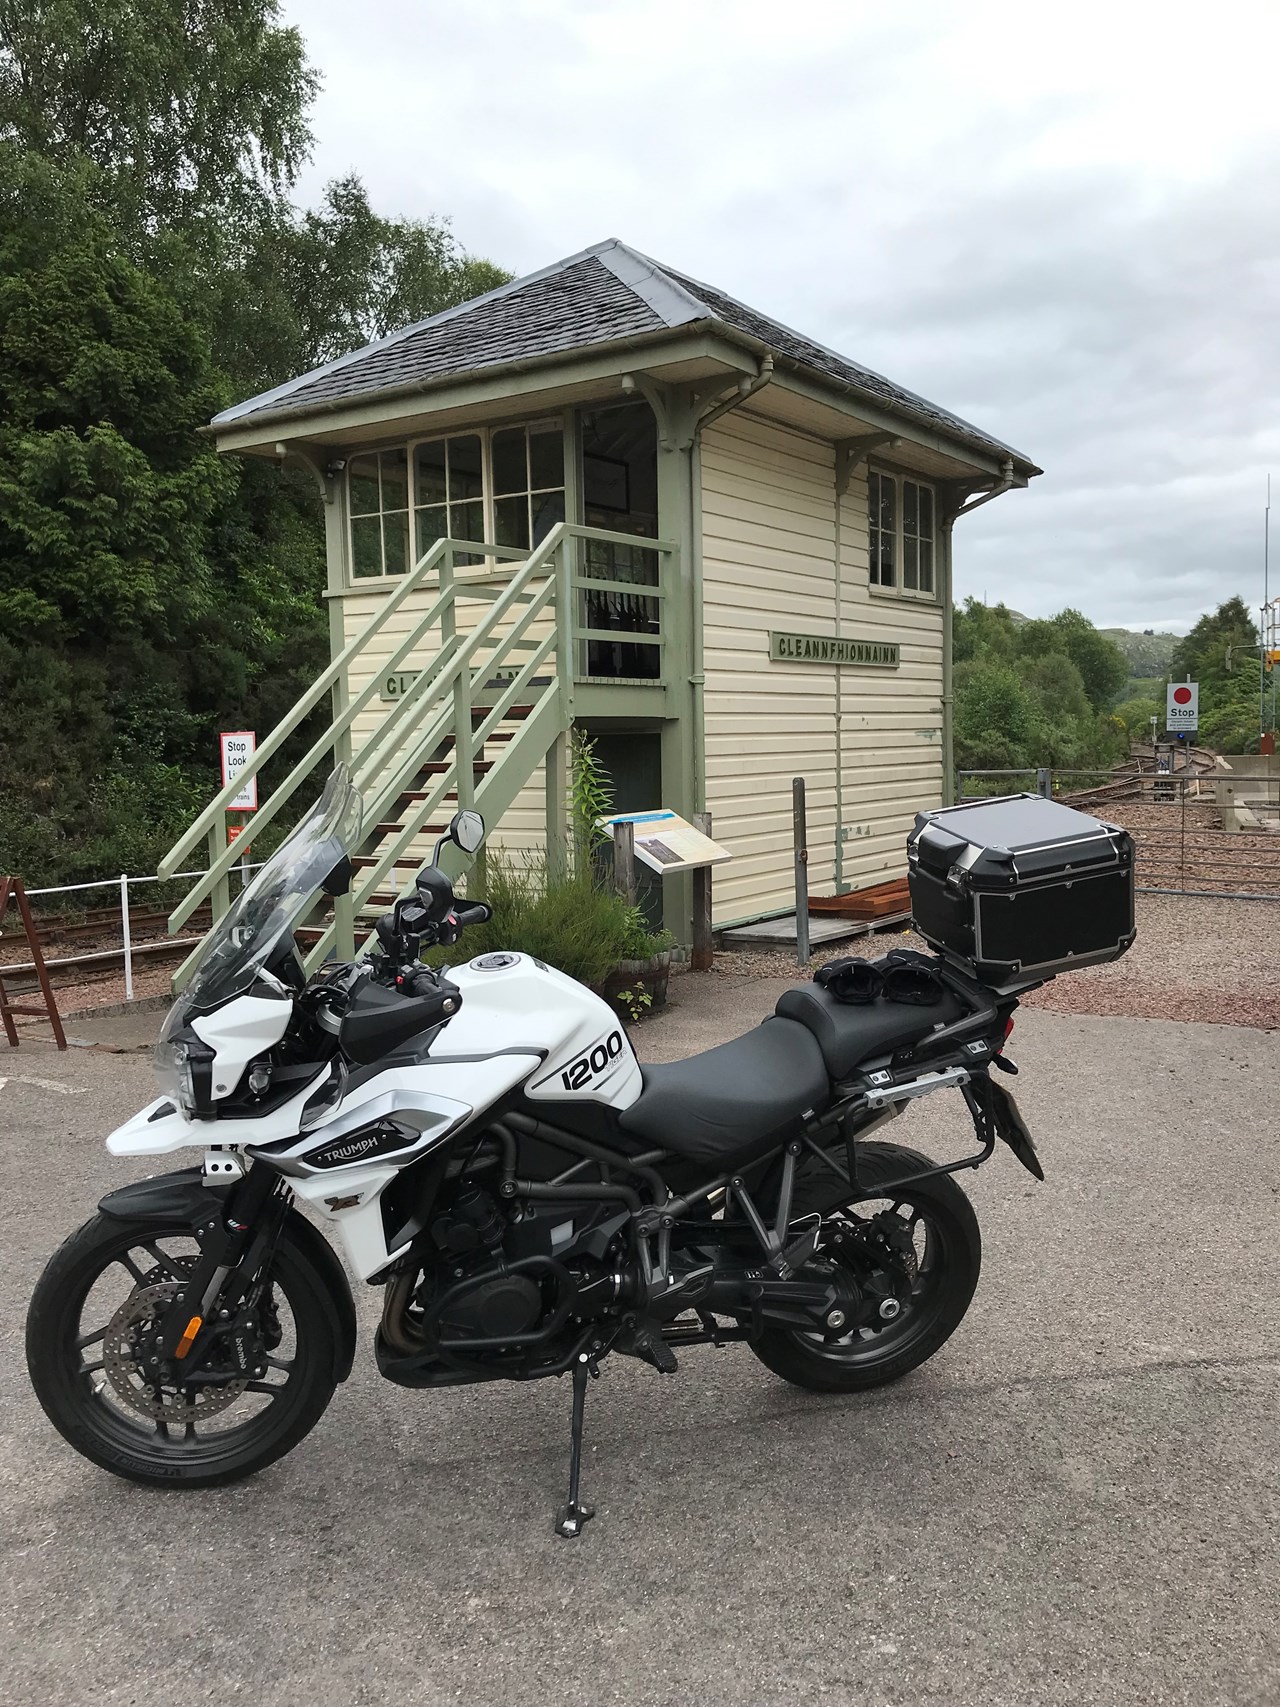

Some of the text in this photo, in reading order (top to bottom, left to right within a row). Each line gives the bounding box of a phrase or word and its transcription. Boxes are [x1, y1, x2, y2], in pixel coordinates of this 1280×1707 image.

[1170, 708, 1195, 717] Stop
[228, 741, 246, 753] Stop
[228, 755, 247, 766] Look
[561, 1030, 622, 1090] 1200
[324, 1137, 378, 1161] TRIUMPH
[235, 1337, 247, 1370] brembo
